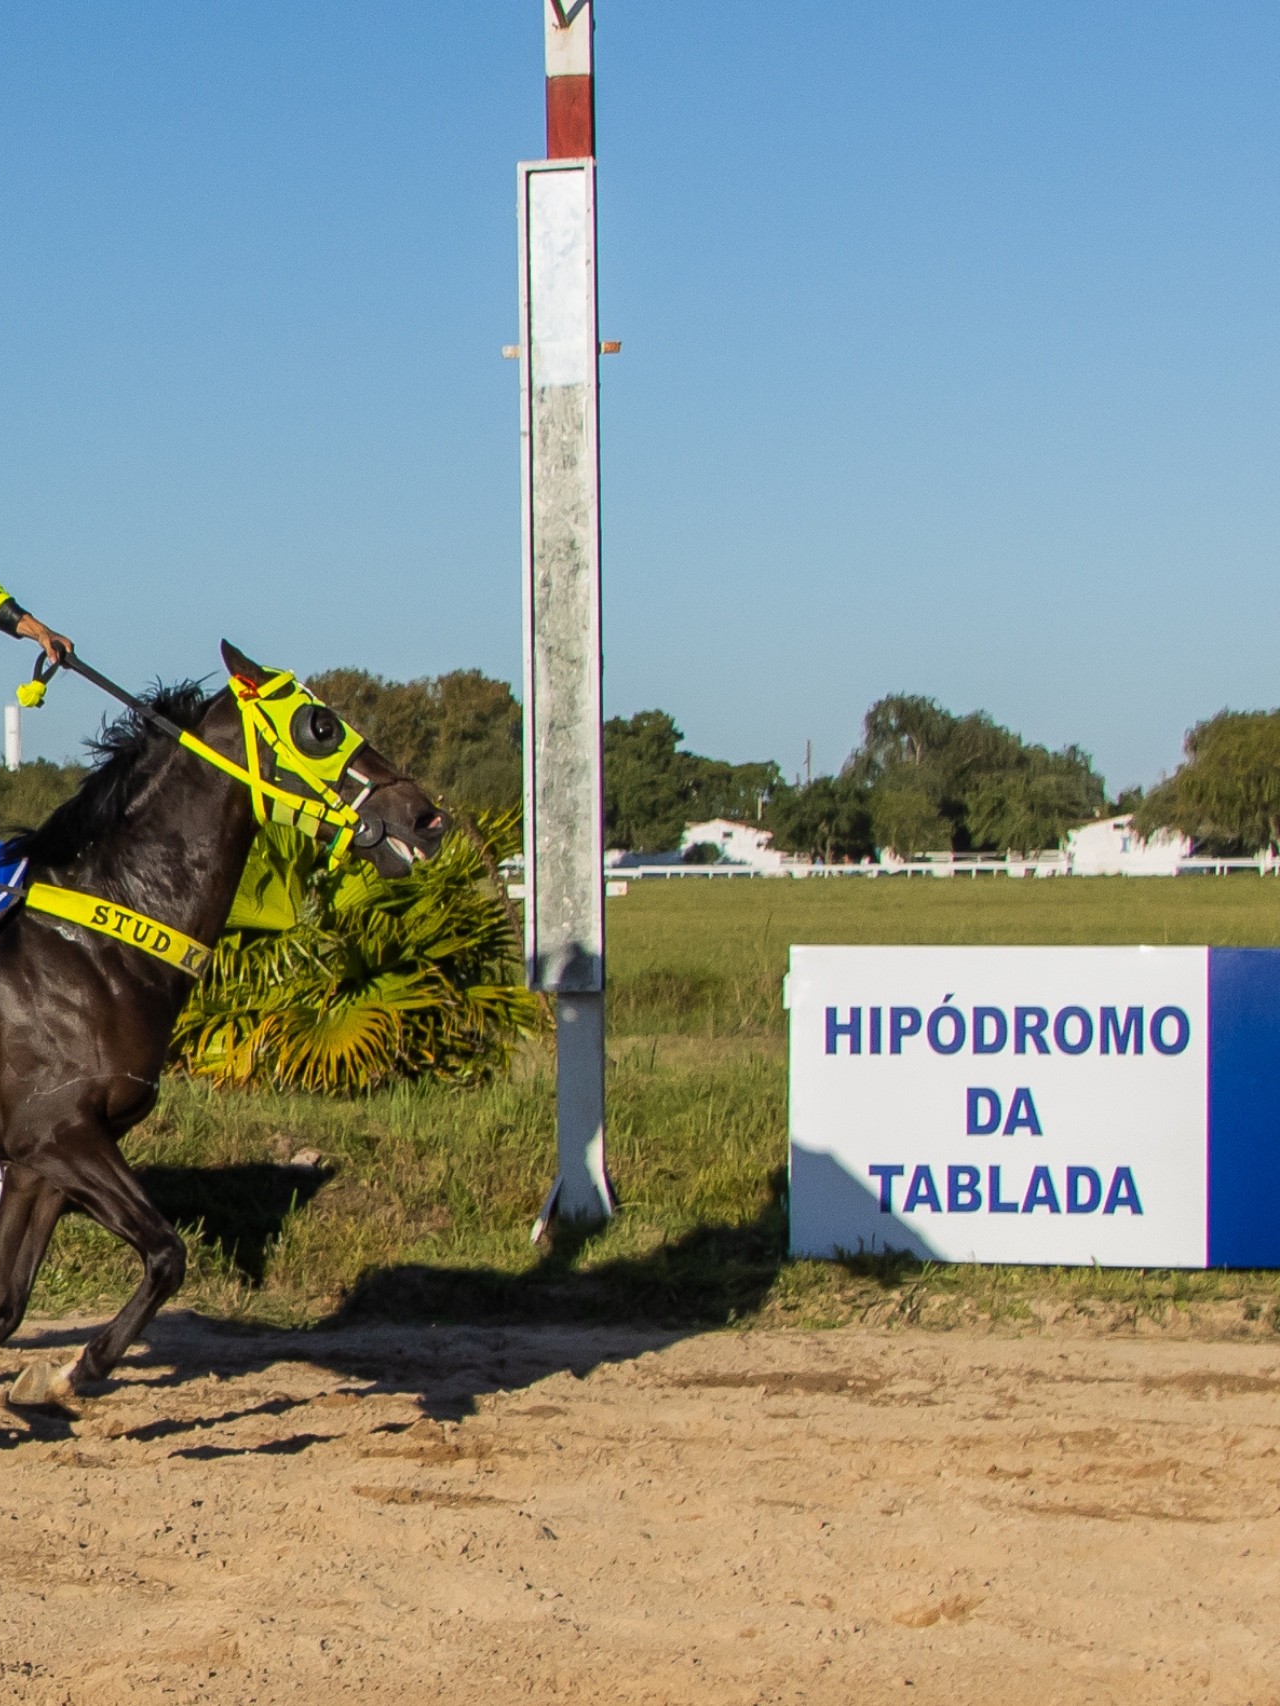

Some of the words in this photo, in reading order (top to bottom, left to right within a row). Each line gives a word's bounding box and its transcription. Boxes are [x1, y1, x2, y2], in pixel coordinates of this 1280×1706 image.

[90, 905, 171, 953] STUD
[824, 993, 1191, 1056] HIPÓDROMO
[965, 1087, 1043, 1136] DA
[868, 1164, 1144, 1215] TABLADA
